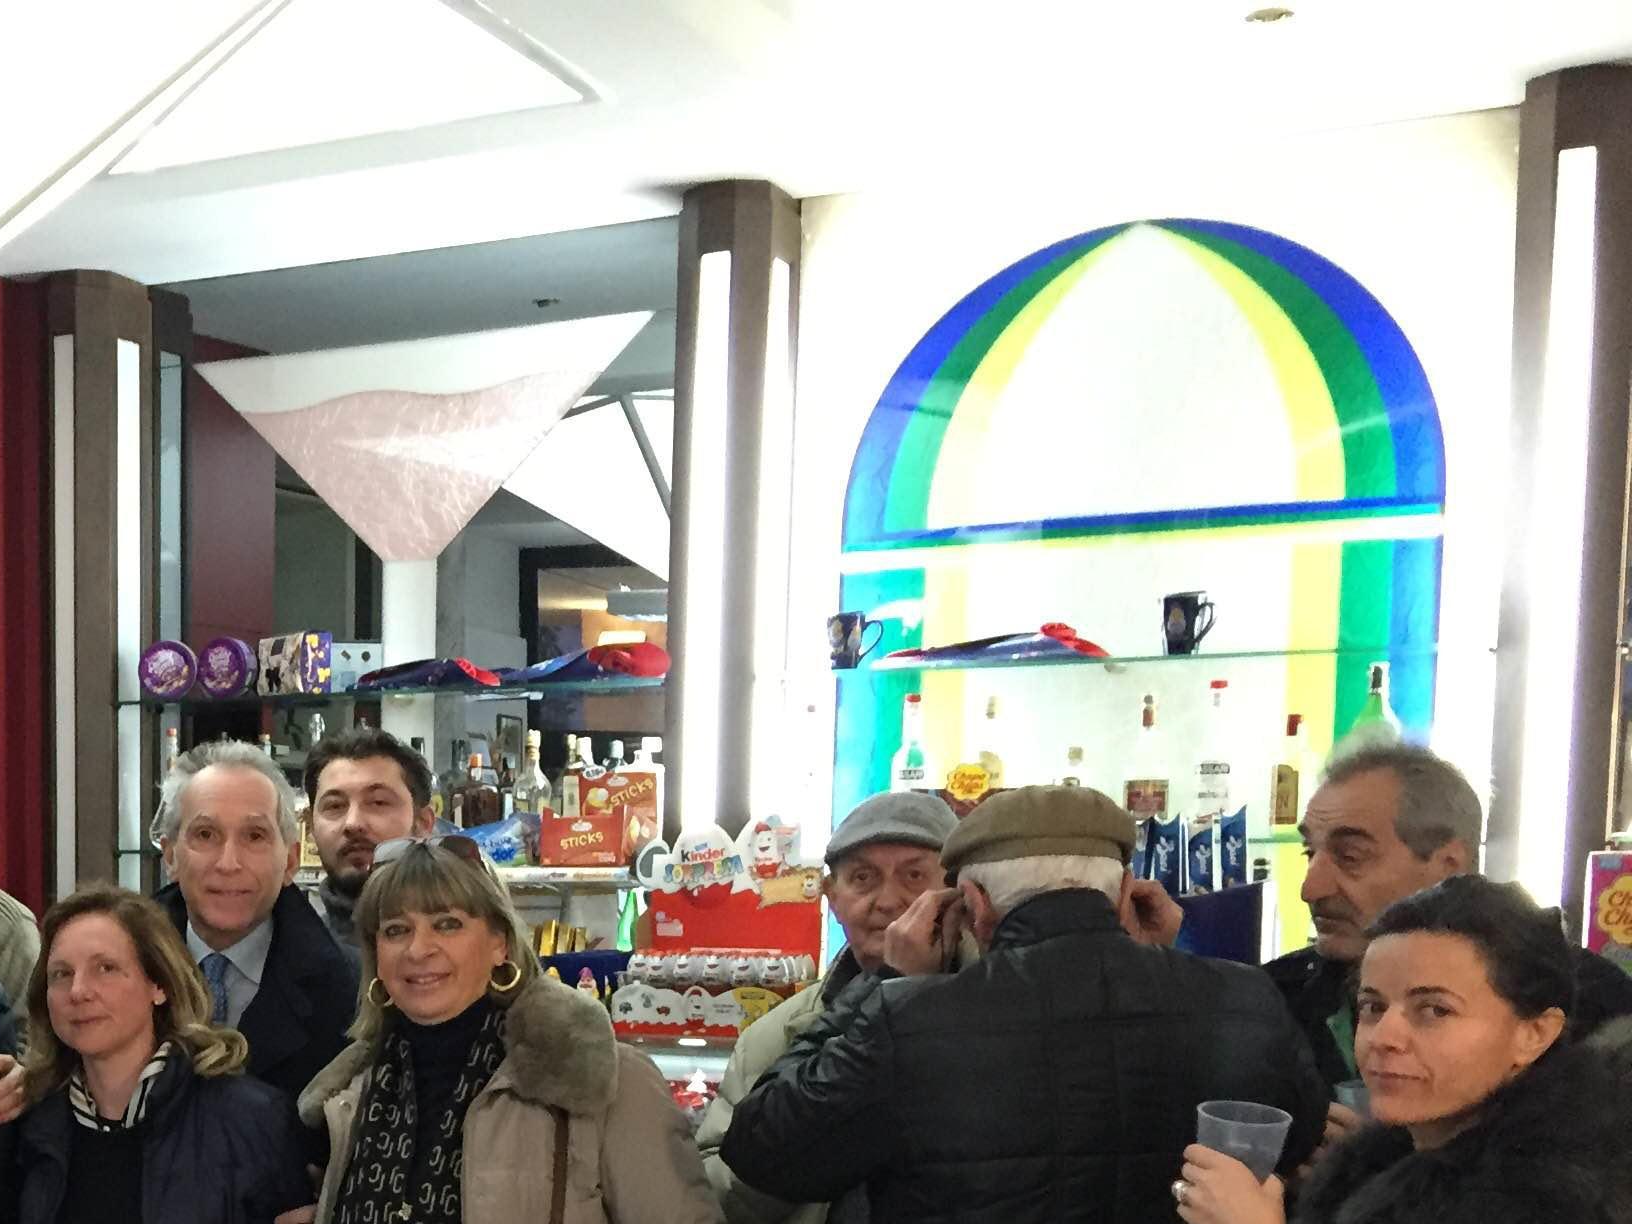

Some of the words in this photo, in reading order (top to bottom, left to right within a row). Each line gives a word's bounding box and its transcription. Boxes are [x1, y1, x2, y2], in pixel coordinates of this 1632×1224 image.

[610, 778, 654, 807] STICKS
[560, 831, 604, 851] STICKS
[680, 847, 726, 863] kinder
